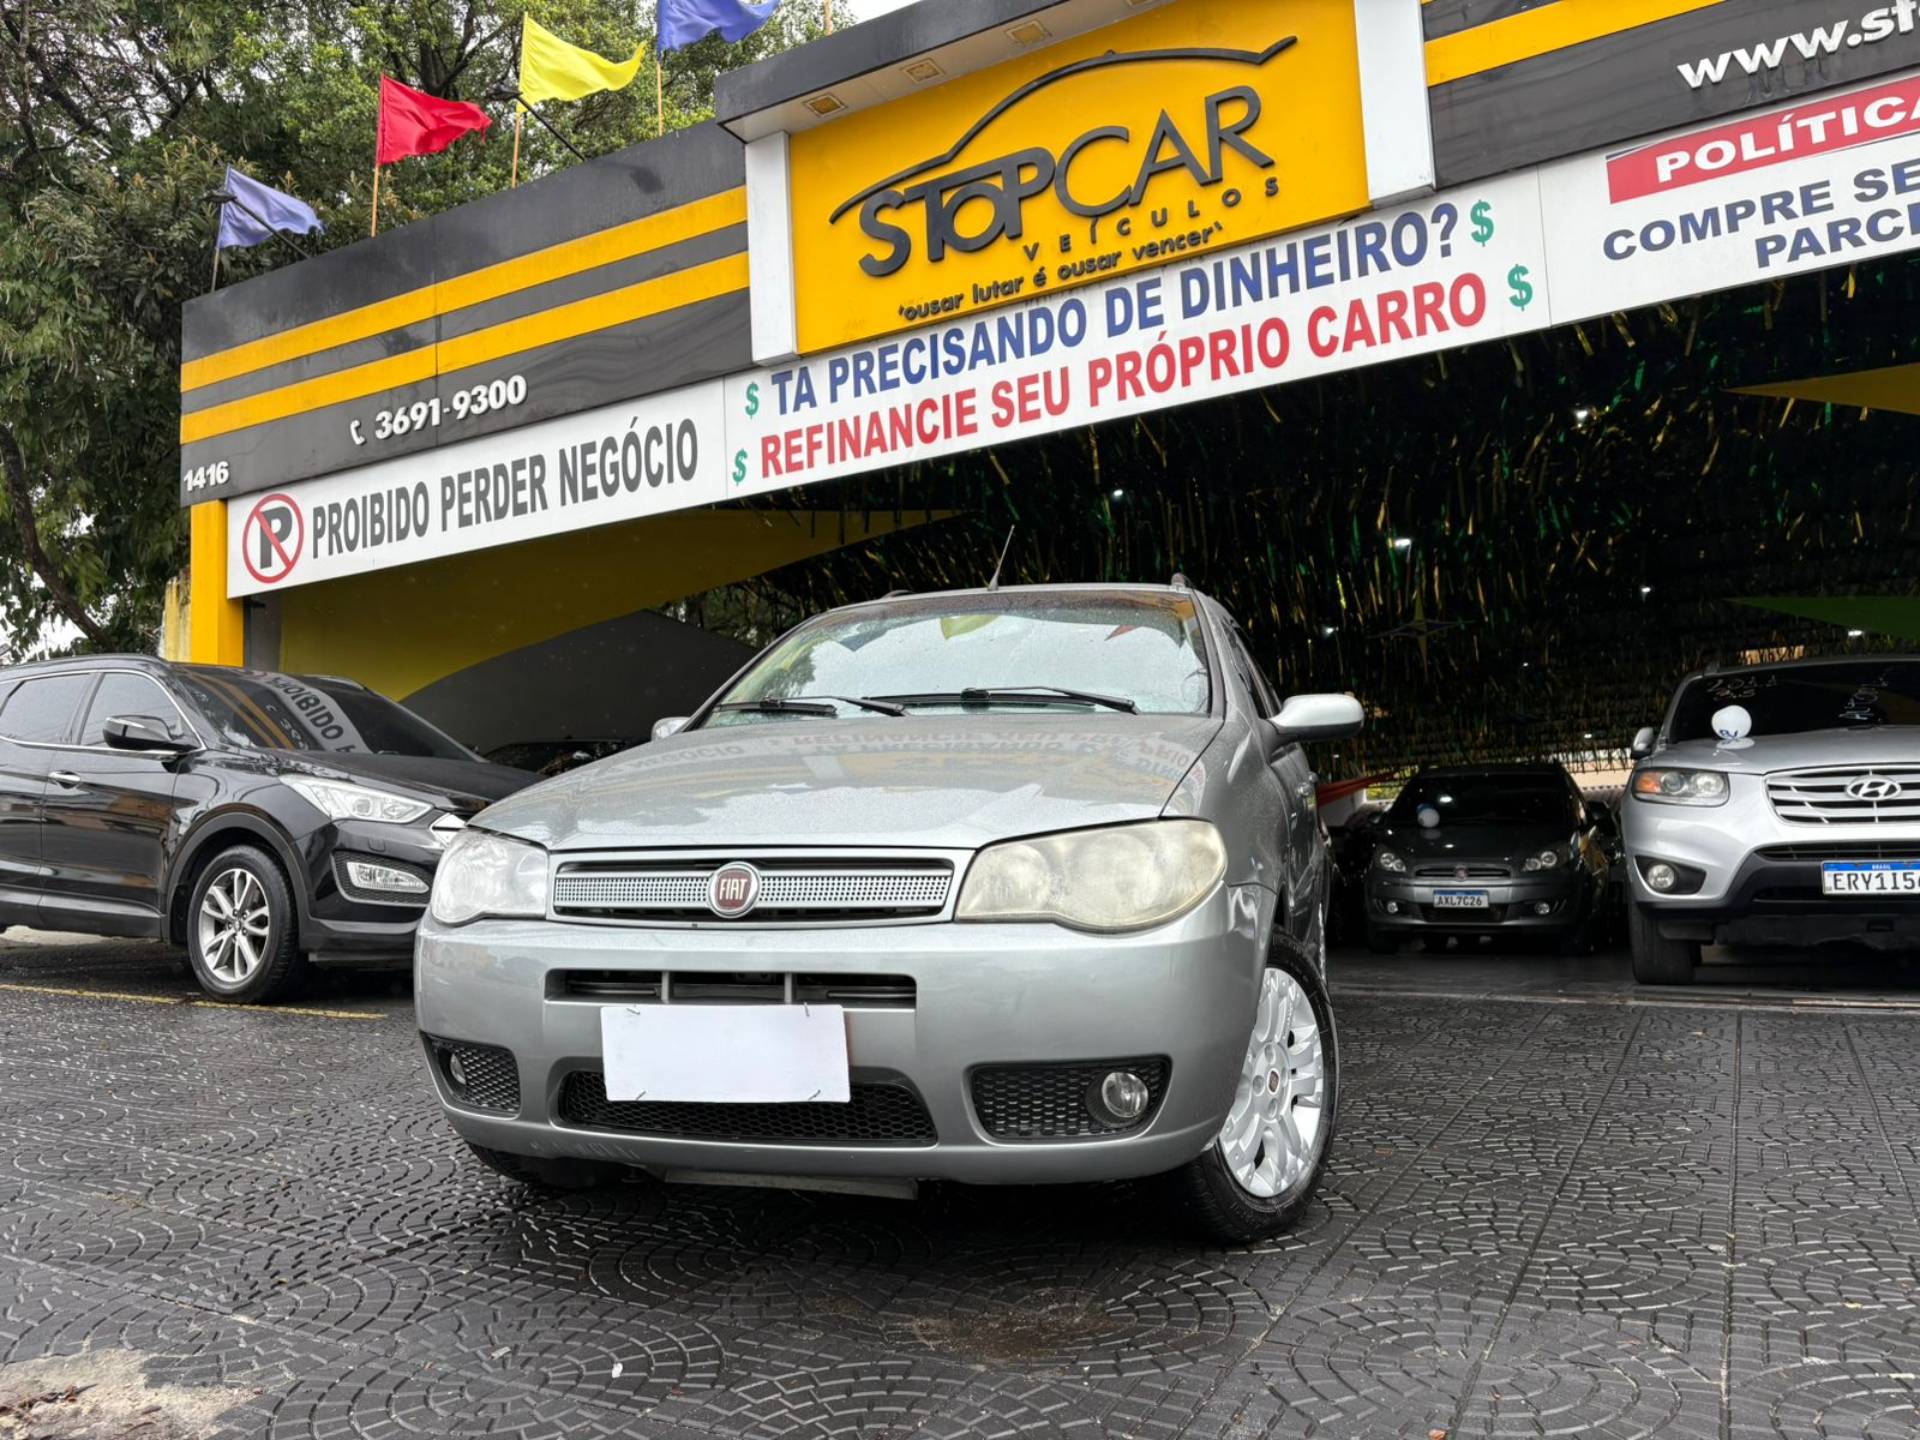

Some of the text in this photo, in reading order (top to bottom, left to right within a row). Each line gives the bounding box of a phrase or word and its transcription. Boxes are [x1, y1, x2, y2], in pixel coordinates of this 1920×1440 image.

[1677, 0, 1920, 88] www.st
[858, 85, 1276, 278] STOPCAR
[1024, 177, 1279, 262] VEÍCULOS
[1602, 180, 1835, 261] COMPRE
[771, 366, 817, 416] TA
[829, 297, 1088, 404] PRECISANDO
[1105, 277, 1164, 338] DE
[1180, 202, 1458, 320] DINHEIRO?
[972, 276, 1025, 304] lutar
[1033, 266, 1047, 287] é
[1057, 250, 1122, 281] ousar
[375, 374, 528, 440] 3691-9300
[761, 388, 979, 479] REFINANCIE
[991, 366, 1071, 428] SEU
[1088, 316, 1290, 408] PRÓPRIO
[1307, 272, 1487, 358] CARRO
[183, 460, 230, 492] 1416
[312, 416, 698, 559] PROIBIDO PERDER NEGÓCIO
[719, 878, 748, 901] FIAT
[1833, 872, 1920, 891] ERY1I5
